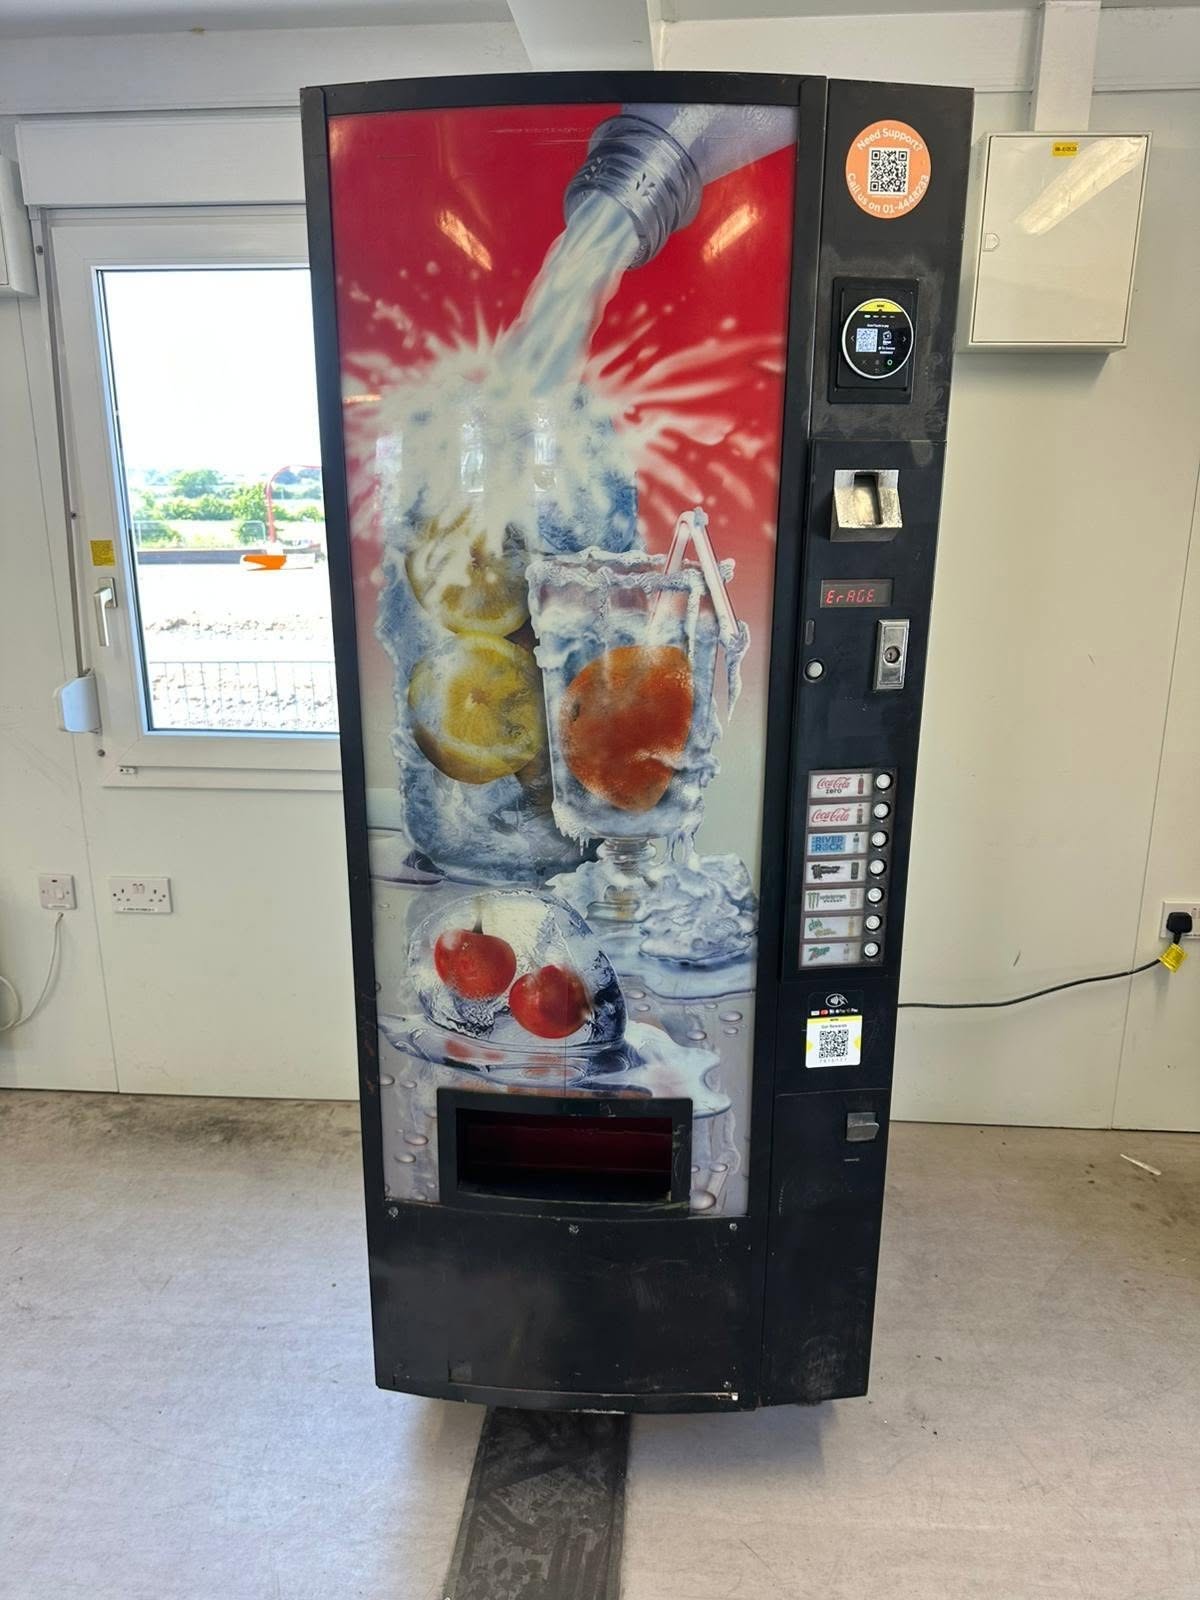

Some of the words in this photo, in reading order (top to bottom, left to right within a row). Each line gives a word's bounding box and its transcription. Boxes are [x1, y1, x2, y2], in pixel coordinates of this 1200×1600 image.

[857, 129, 881, 150] Need
[883, 128, 924, 152] Support?
[848, 173, 862, 195] Call
[858, 194, 868, 205] us
[869, 202, 881, 212] on
